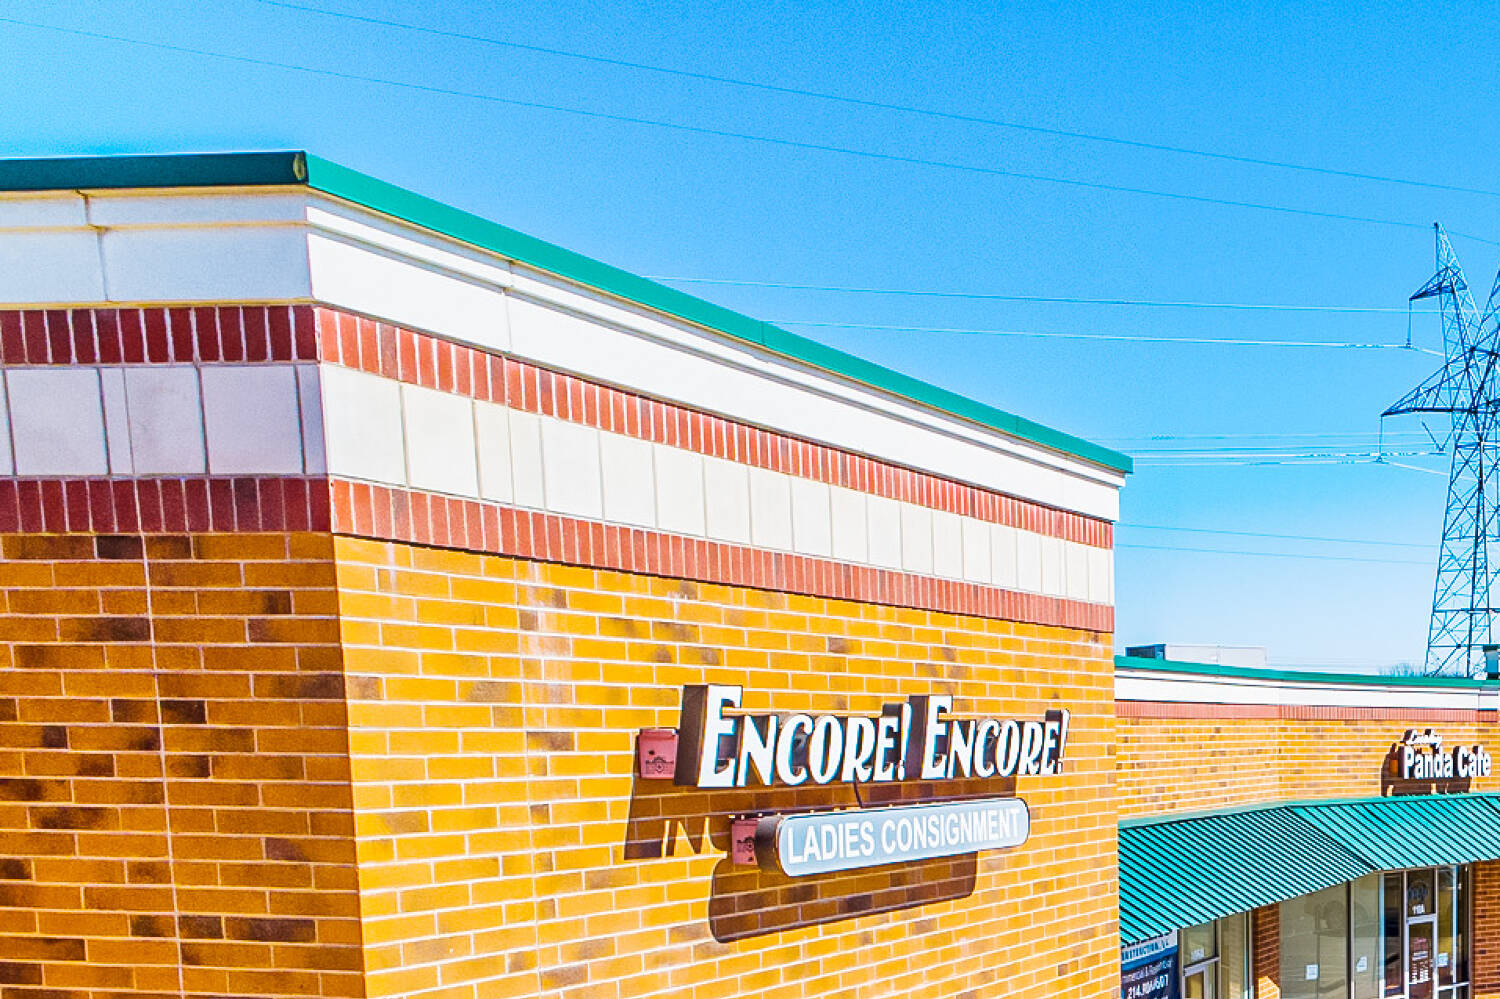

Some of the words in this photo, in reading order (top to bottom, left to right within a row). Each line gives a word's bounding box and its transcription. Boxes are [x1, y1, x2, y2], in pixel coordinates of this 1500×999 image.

[698, 684, 912, 788] ENCORE!
[921, 695, 1070, 780] ENCORE!
[1404, 744, 1453, 779] Panda
[1458, 744, 1492, 778] Cafe
[787, 821, 876, 864] LADIES
[881, 808, 1021, 855] CONSIGNMENT
